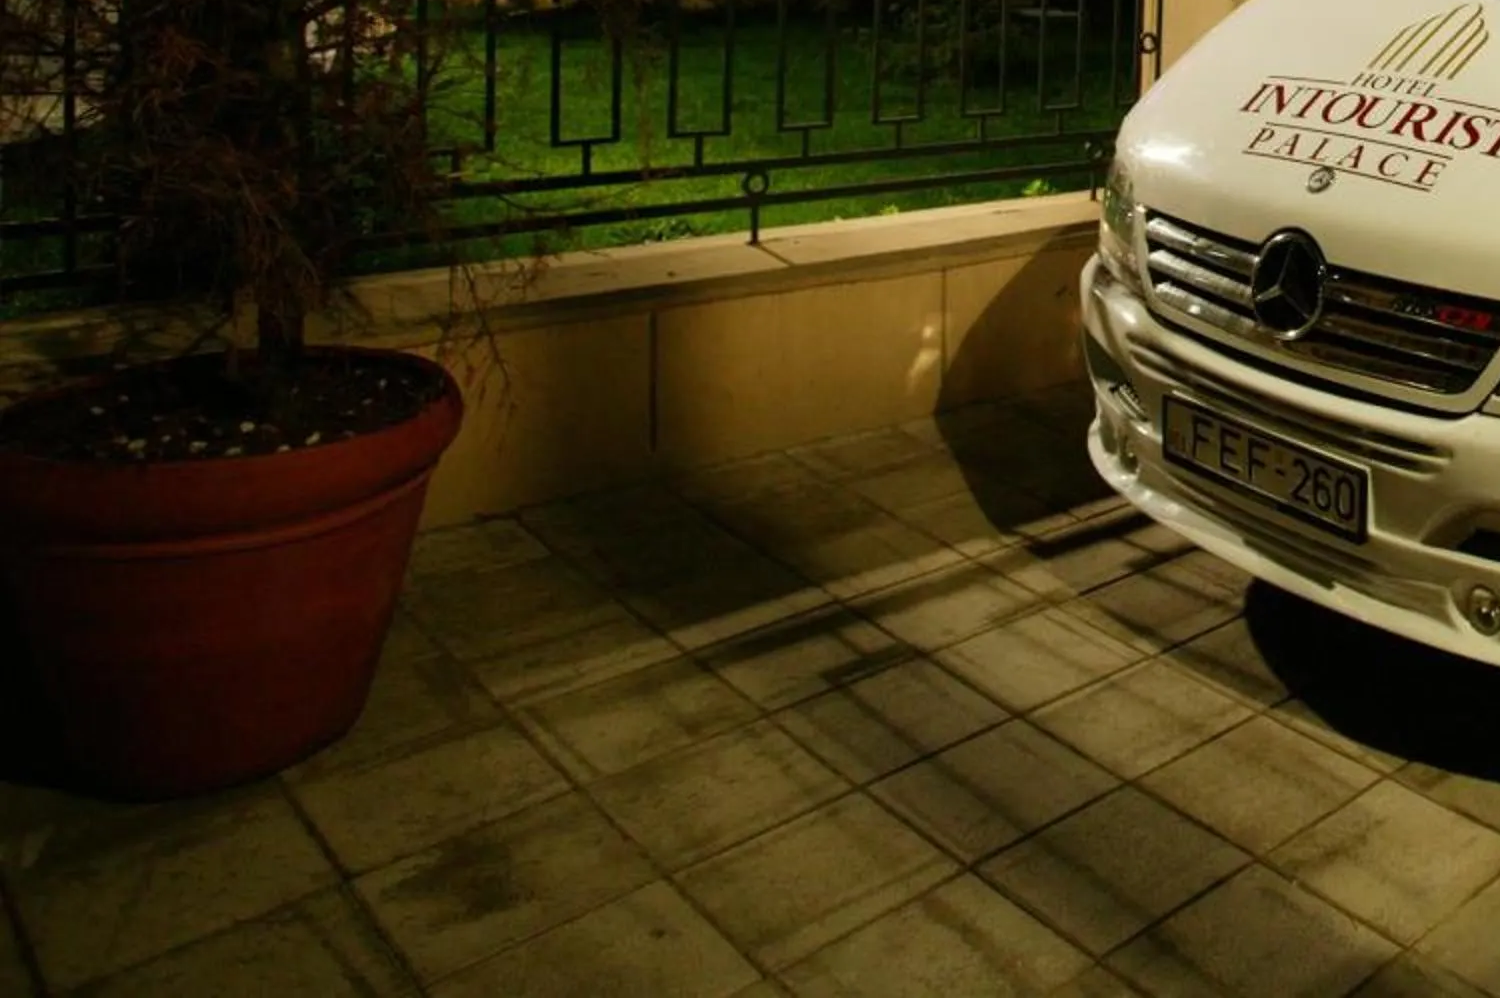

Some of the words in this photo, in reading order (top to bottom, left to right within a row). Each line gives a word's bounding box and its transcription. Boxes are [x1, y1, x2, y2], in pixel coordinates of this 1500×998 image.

[1350, 71, 1437, 98] HOTEL
[1249, 127, 1448, 188] PALACE
[1190, 413, 1357, 522] FEF-260
